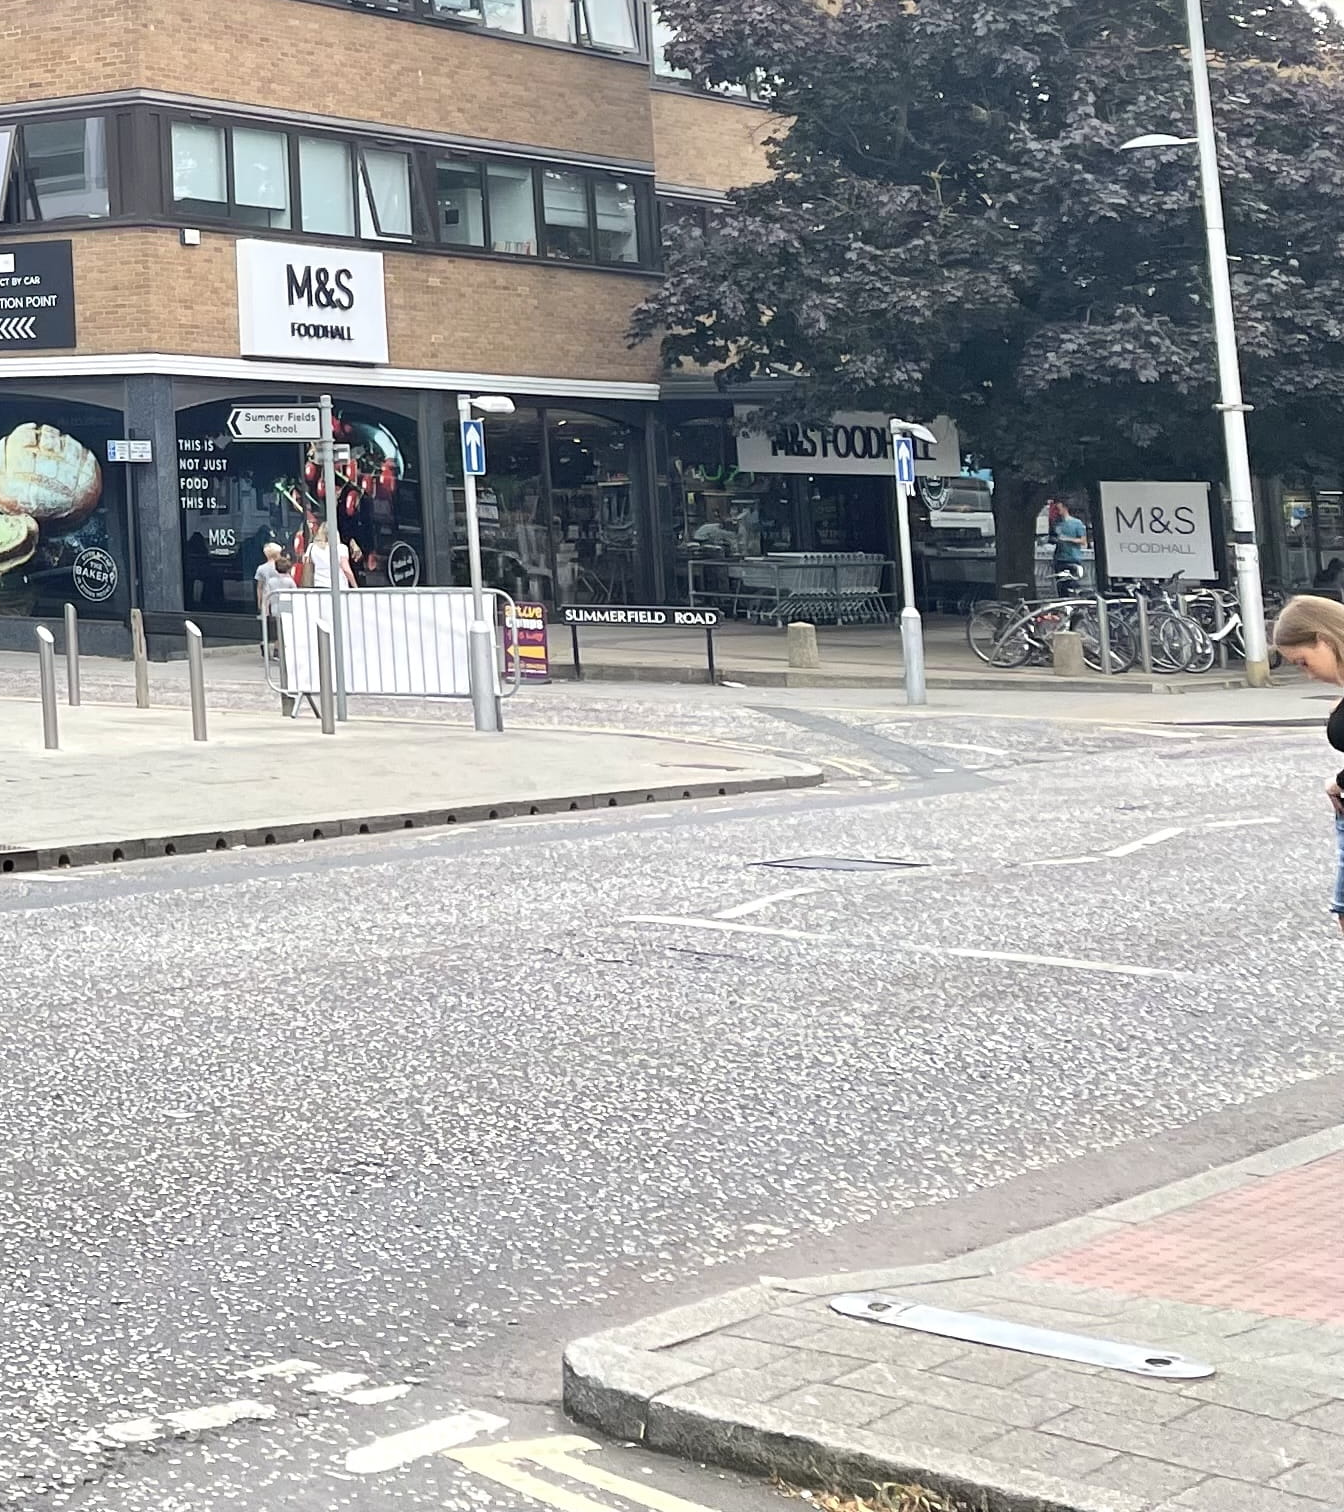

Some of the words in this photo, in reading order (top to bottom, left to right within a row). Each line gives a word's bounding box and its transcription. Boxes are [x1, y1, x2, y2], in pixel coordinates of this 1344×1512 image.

[11, 277, 22, 286] BY
[24, 275, 41, 285] CAR
[286, 263, 355, 311] M&S
[25, 294, 58, 308] POINT
[290, 321, 354, 341] FOODHALL
[244, 412, 284, 422] Summer
[287, 411, 316, 422] Fields
[263, 424, 298, 434] School
[178, 439, 201, 451] THIS
[204, 440, 214, 451] IS
[179, 458, 200, 470] NOT
[202, 459, 227, 471] JUST
[180, 477, 209, 490] FOOD
[180, 497, 204, 509] THIS
[1115, 505, 1196, 535] M&S
[208, 528, 236, 546] M&S
[1120, 542, 1196, 555] FOODHALL
[564, 608, 666, 624] SUMMERFIELD
[674, 611, 717, 625] ROAD
